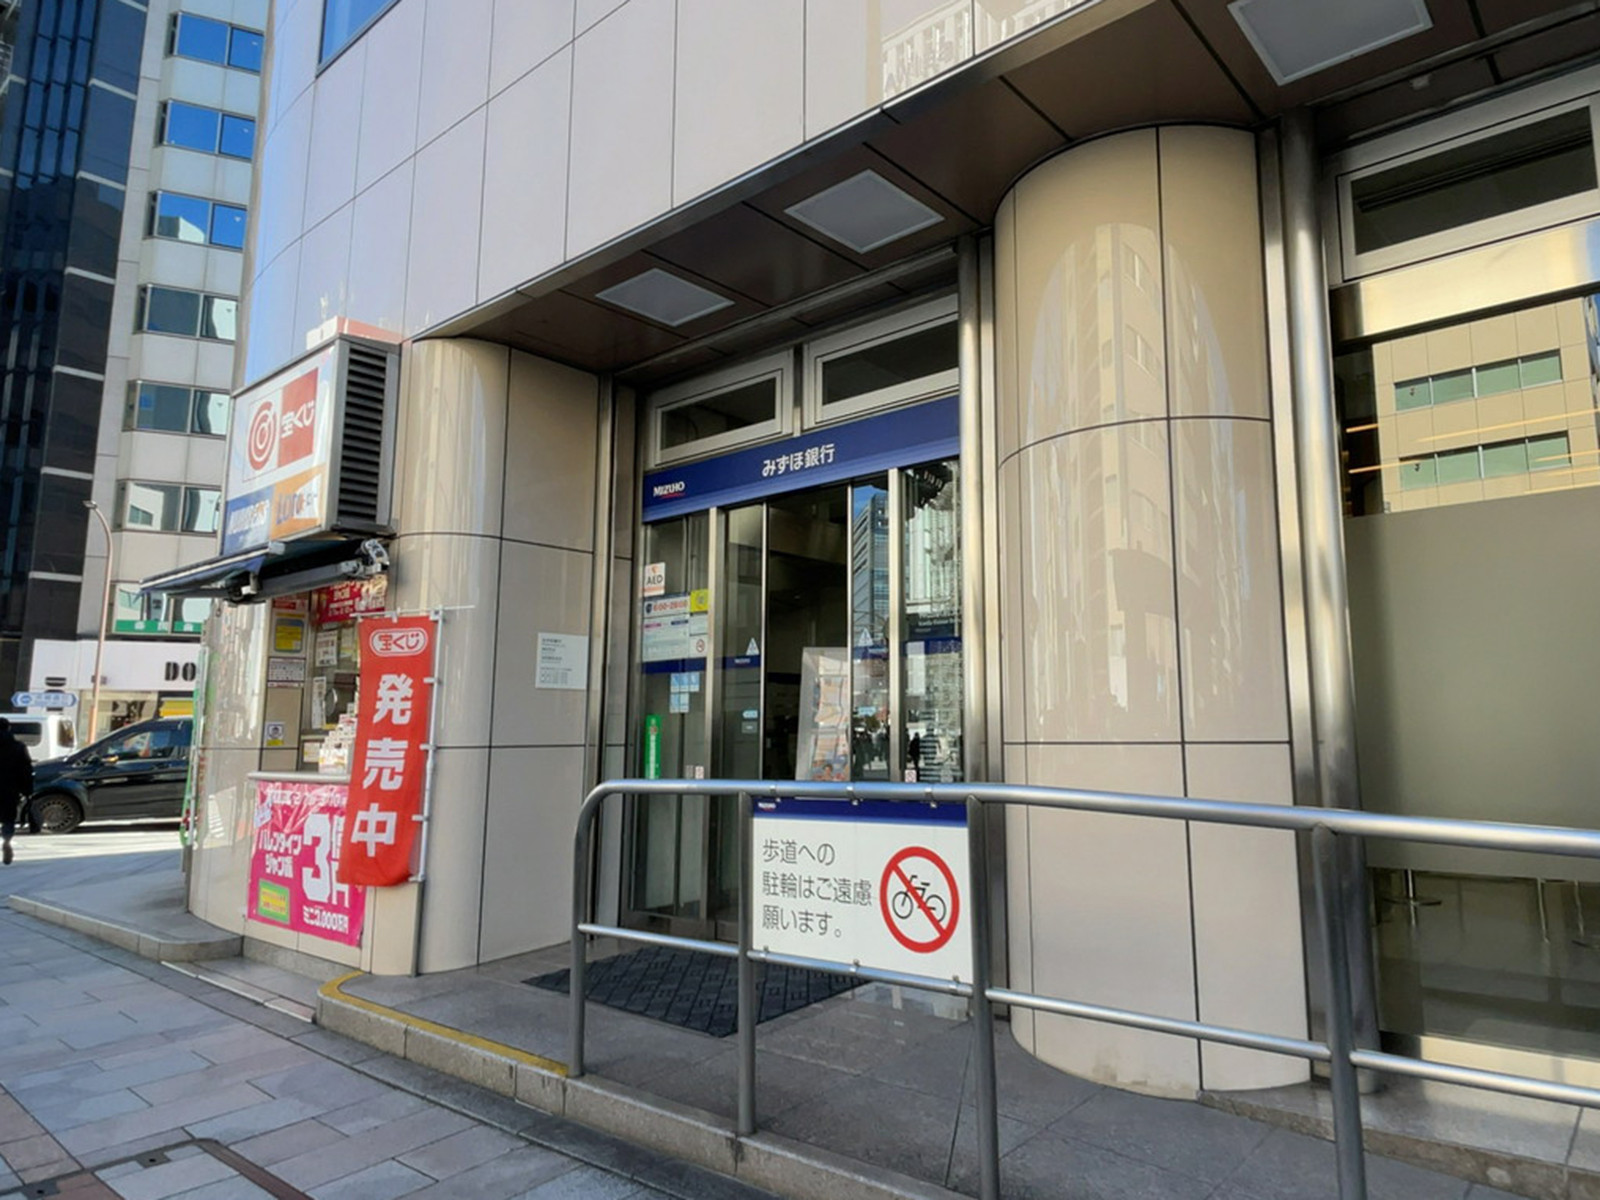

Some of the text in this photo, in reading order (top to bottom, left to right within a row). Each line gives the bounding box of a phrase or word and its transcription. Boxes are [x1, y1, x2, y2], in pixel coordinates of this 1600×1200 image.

[281, 402, 315, 438] 宝くじ
[762, 444, 835, 477] みずほ銀行
[653, 481, 685, 497] MIZUHO
[646, 574, 663, 585] AED
[377, 633, 421, 651] 宝くじ
[351, 673, 413, 858] 発売中
[762, 838, 835, 866] 歩道への
[762, 871, 872, 906] 駐輪はご遠慮
[762, 904, 842, 938] 願います。
